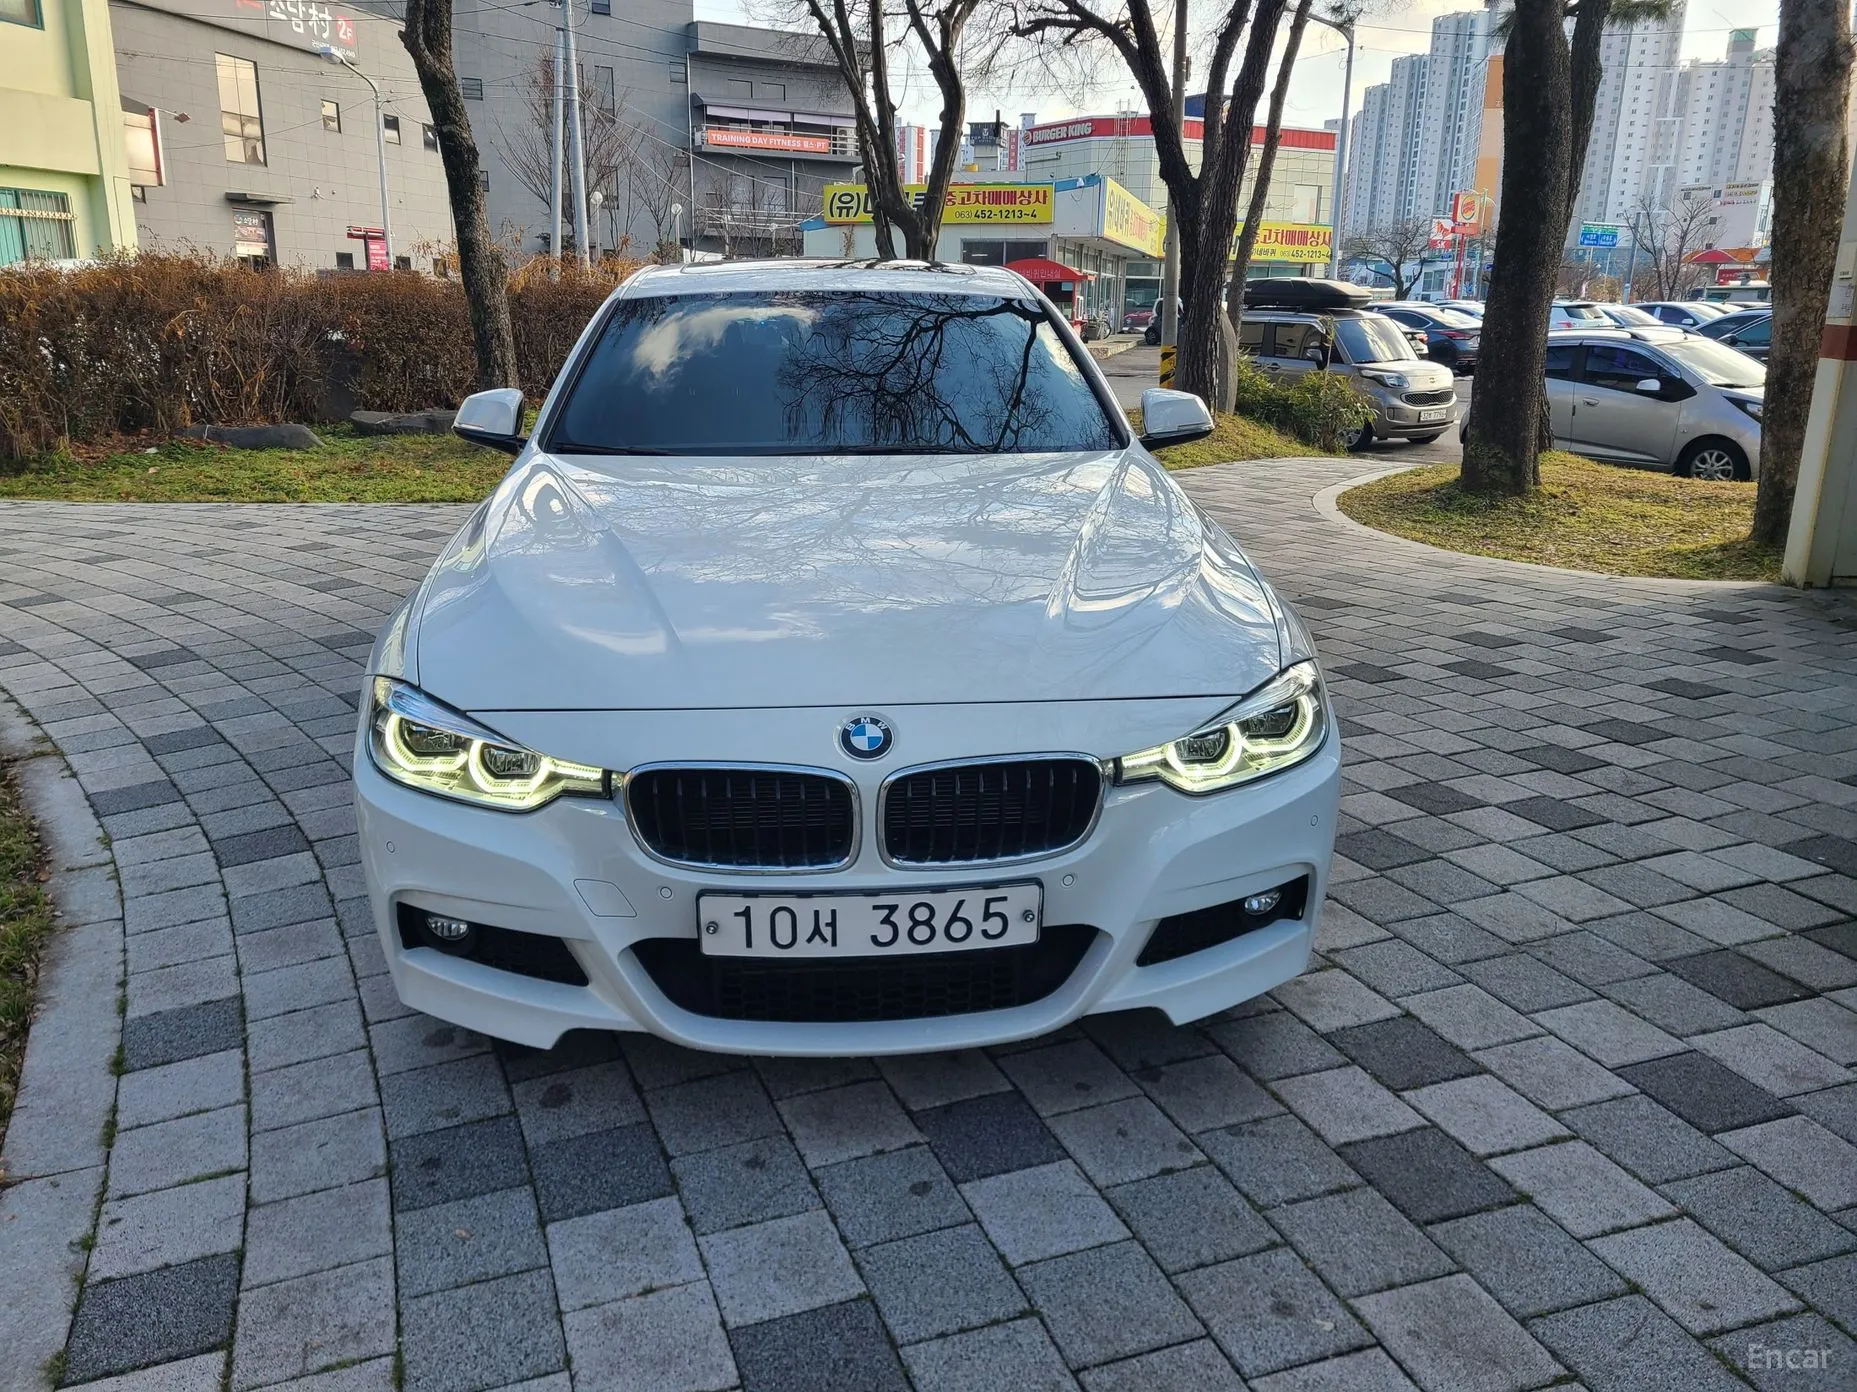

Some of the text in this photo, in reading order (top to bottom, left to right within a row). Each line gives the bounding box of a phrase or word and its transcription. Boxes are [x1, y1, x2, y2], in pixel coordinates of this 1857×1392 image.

[338, 18, 352, 40] 2F
[1033, 122, 1092, 143] BURGER KING
[711, 134, 751, 144] TRAINING
[752, 137, 768, 145] DAY
[769, 138, 801, 148] FITNESS
[945, 190, 1048, 207] 중고차매매상사
[955, 209, 1037, 219] 063) 452-1213~4
[1436, 240, 1446, 249] SK
[845, 717, 888, 731] BMW
[733, 896, 1009, 950] 10서 3865
